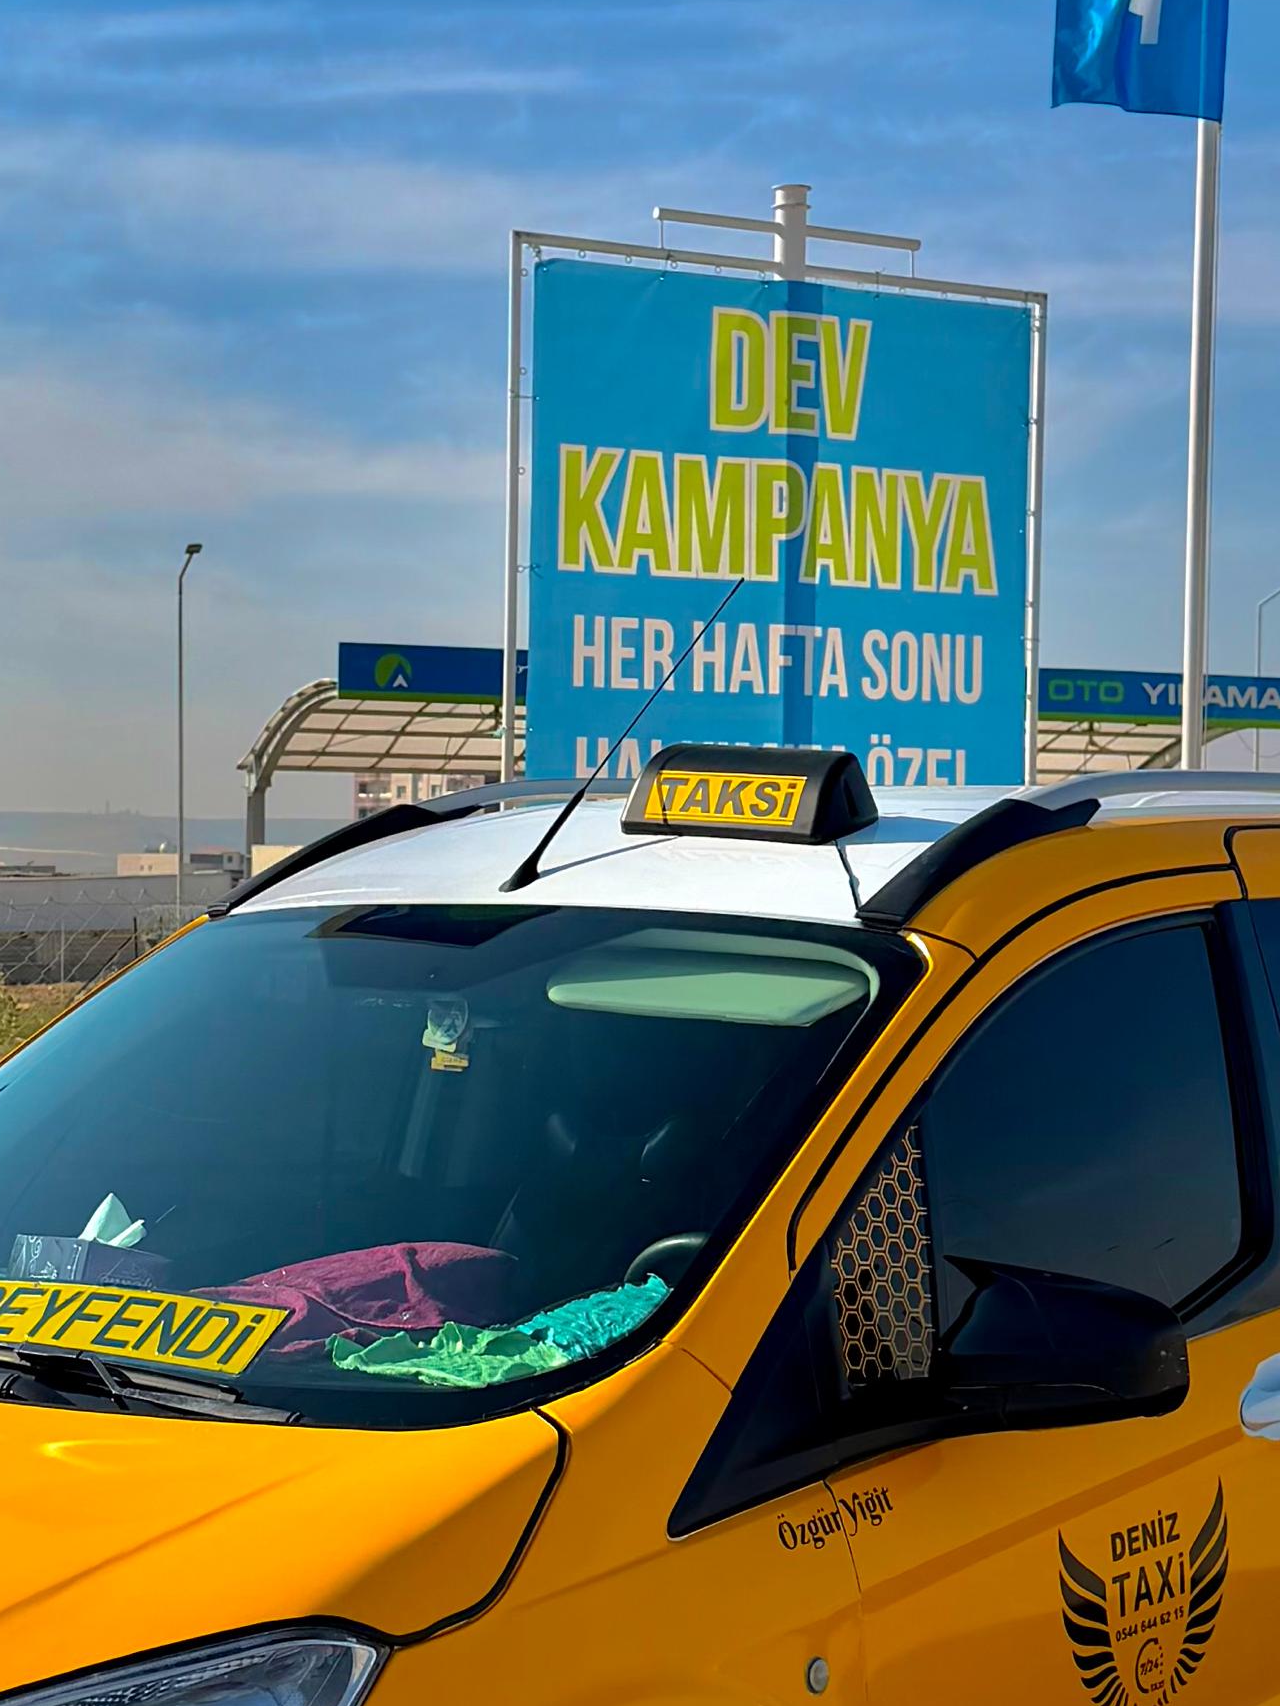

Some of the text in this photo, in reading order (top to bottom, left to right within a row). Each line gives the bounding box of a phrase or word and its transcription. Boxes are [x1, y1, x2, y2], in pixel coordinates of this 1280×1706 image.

[709, 305, 872, 441] DEV
[556, 443, 999, 596] KAMPANYA
[573, 614, 983, 705] HER HAFTA SONU
[1048, 679, 1124, 703] OTO
[777, 1507, 842, 1551] Özgür
[1110, 1509, 1181, 1564] DENİZ
[1115, 1623, 1138, 1643] 0544
[1140, 1616, 1158, 1633] 644
[1174, 1605, 1185, 1621] 15
